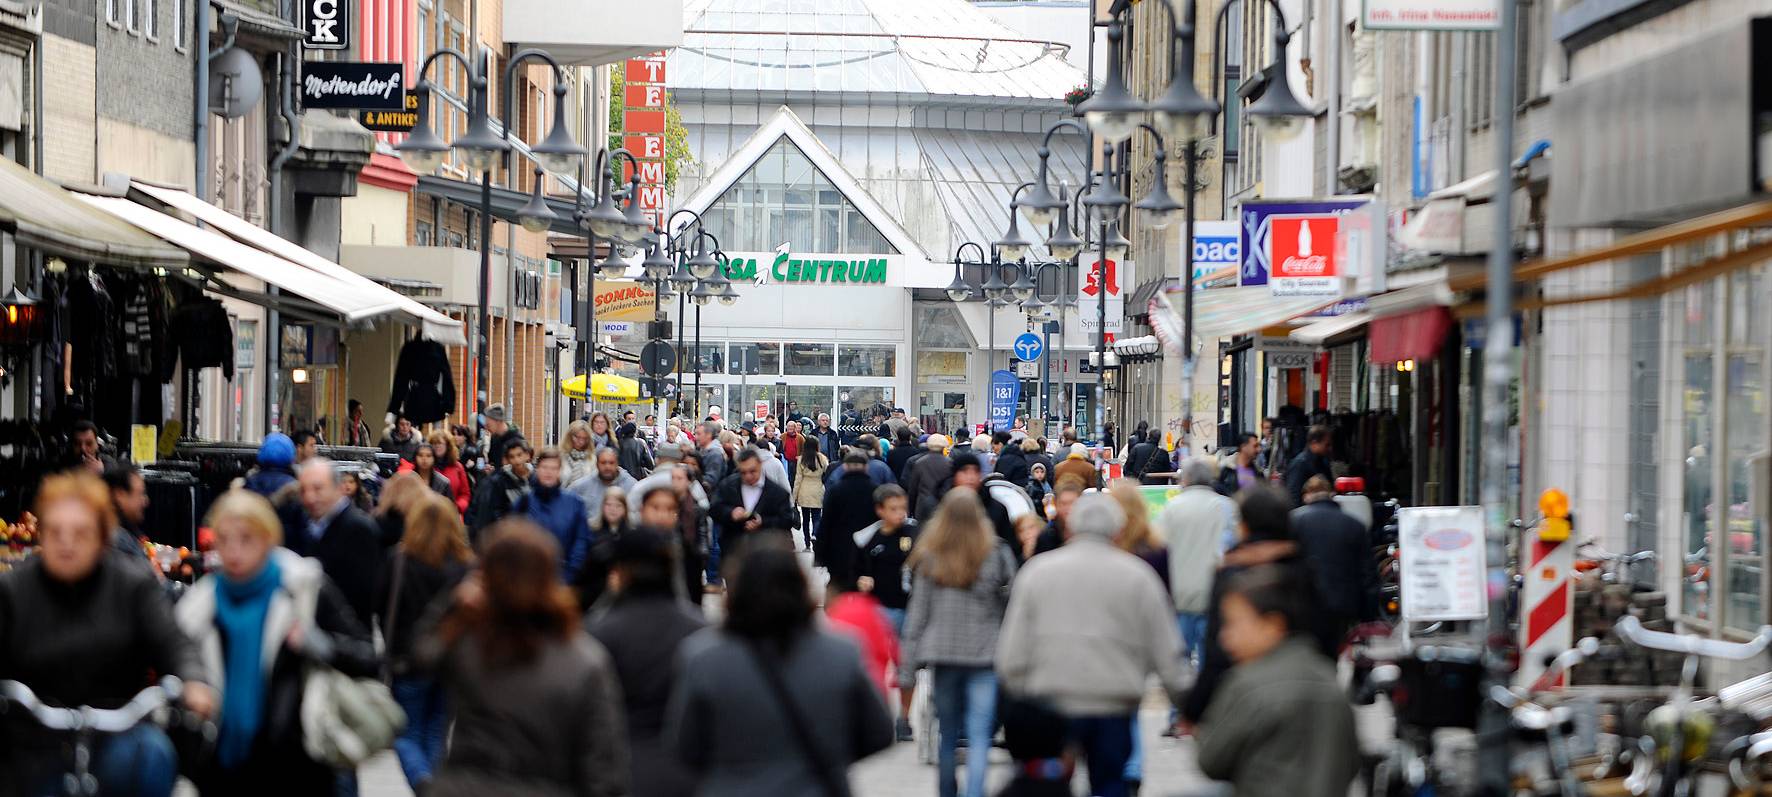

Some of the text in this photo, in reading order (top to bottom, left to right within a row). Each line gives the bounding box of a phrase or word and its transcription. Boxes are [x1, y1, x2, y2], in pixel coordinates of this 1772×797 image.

[312, 0, 339, 42] CK
[305, 72, 400, 99] Mettendorf
[366, 111, 375, 125] &
[772, 253, 888, 283] CENTRUM
[1081, 318, 1120, 329] Spinrad
[1273, 353, 1309, 366] KIOSK
[995, 387, 1012, 399] 1&1
